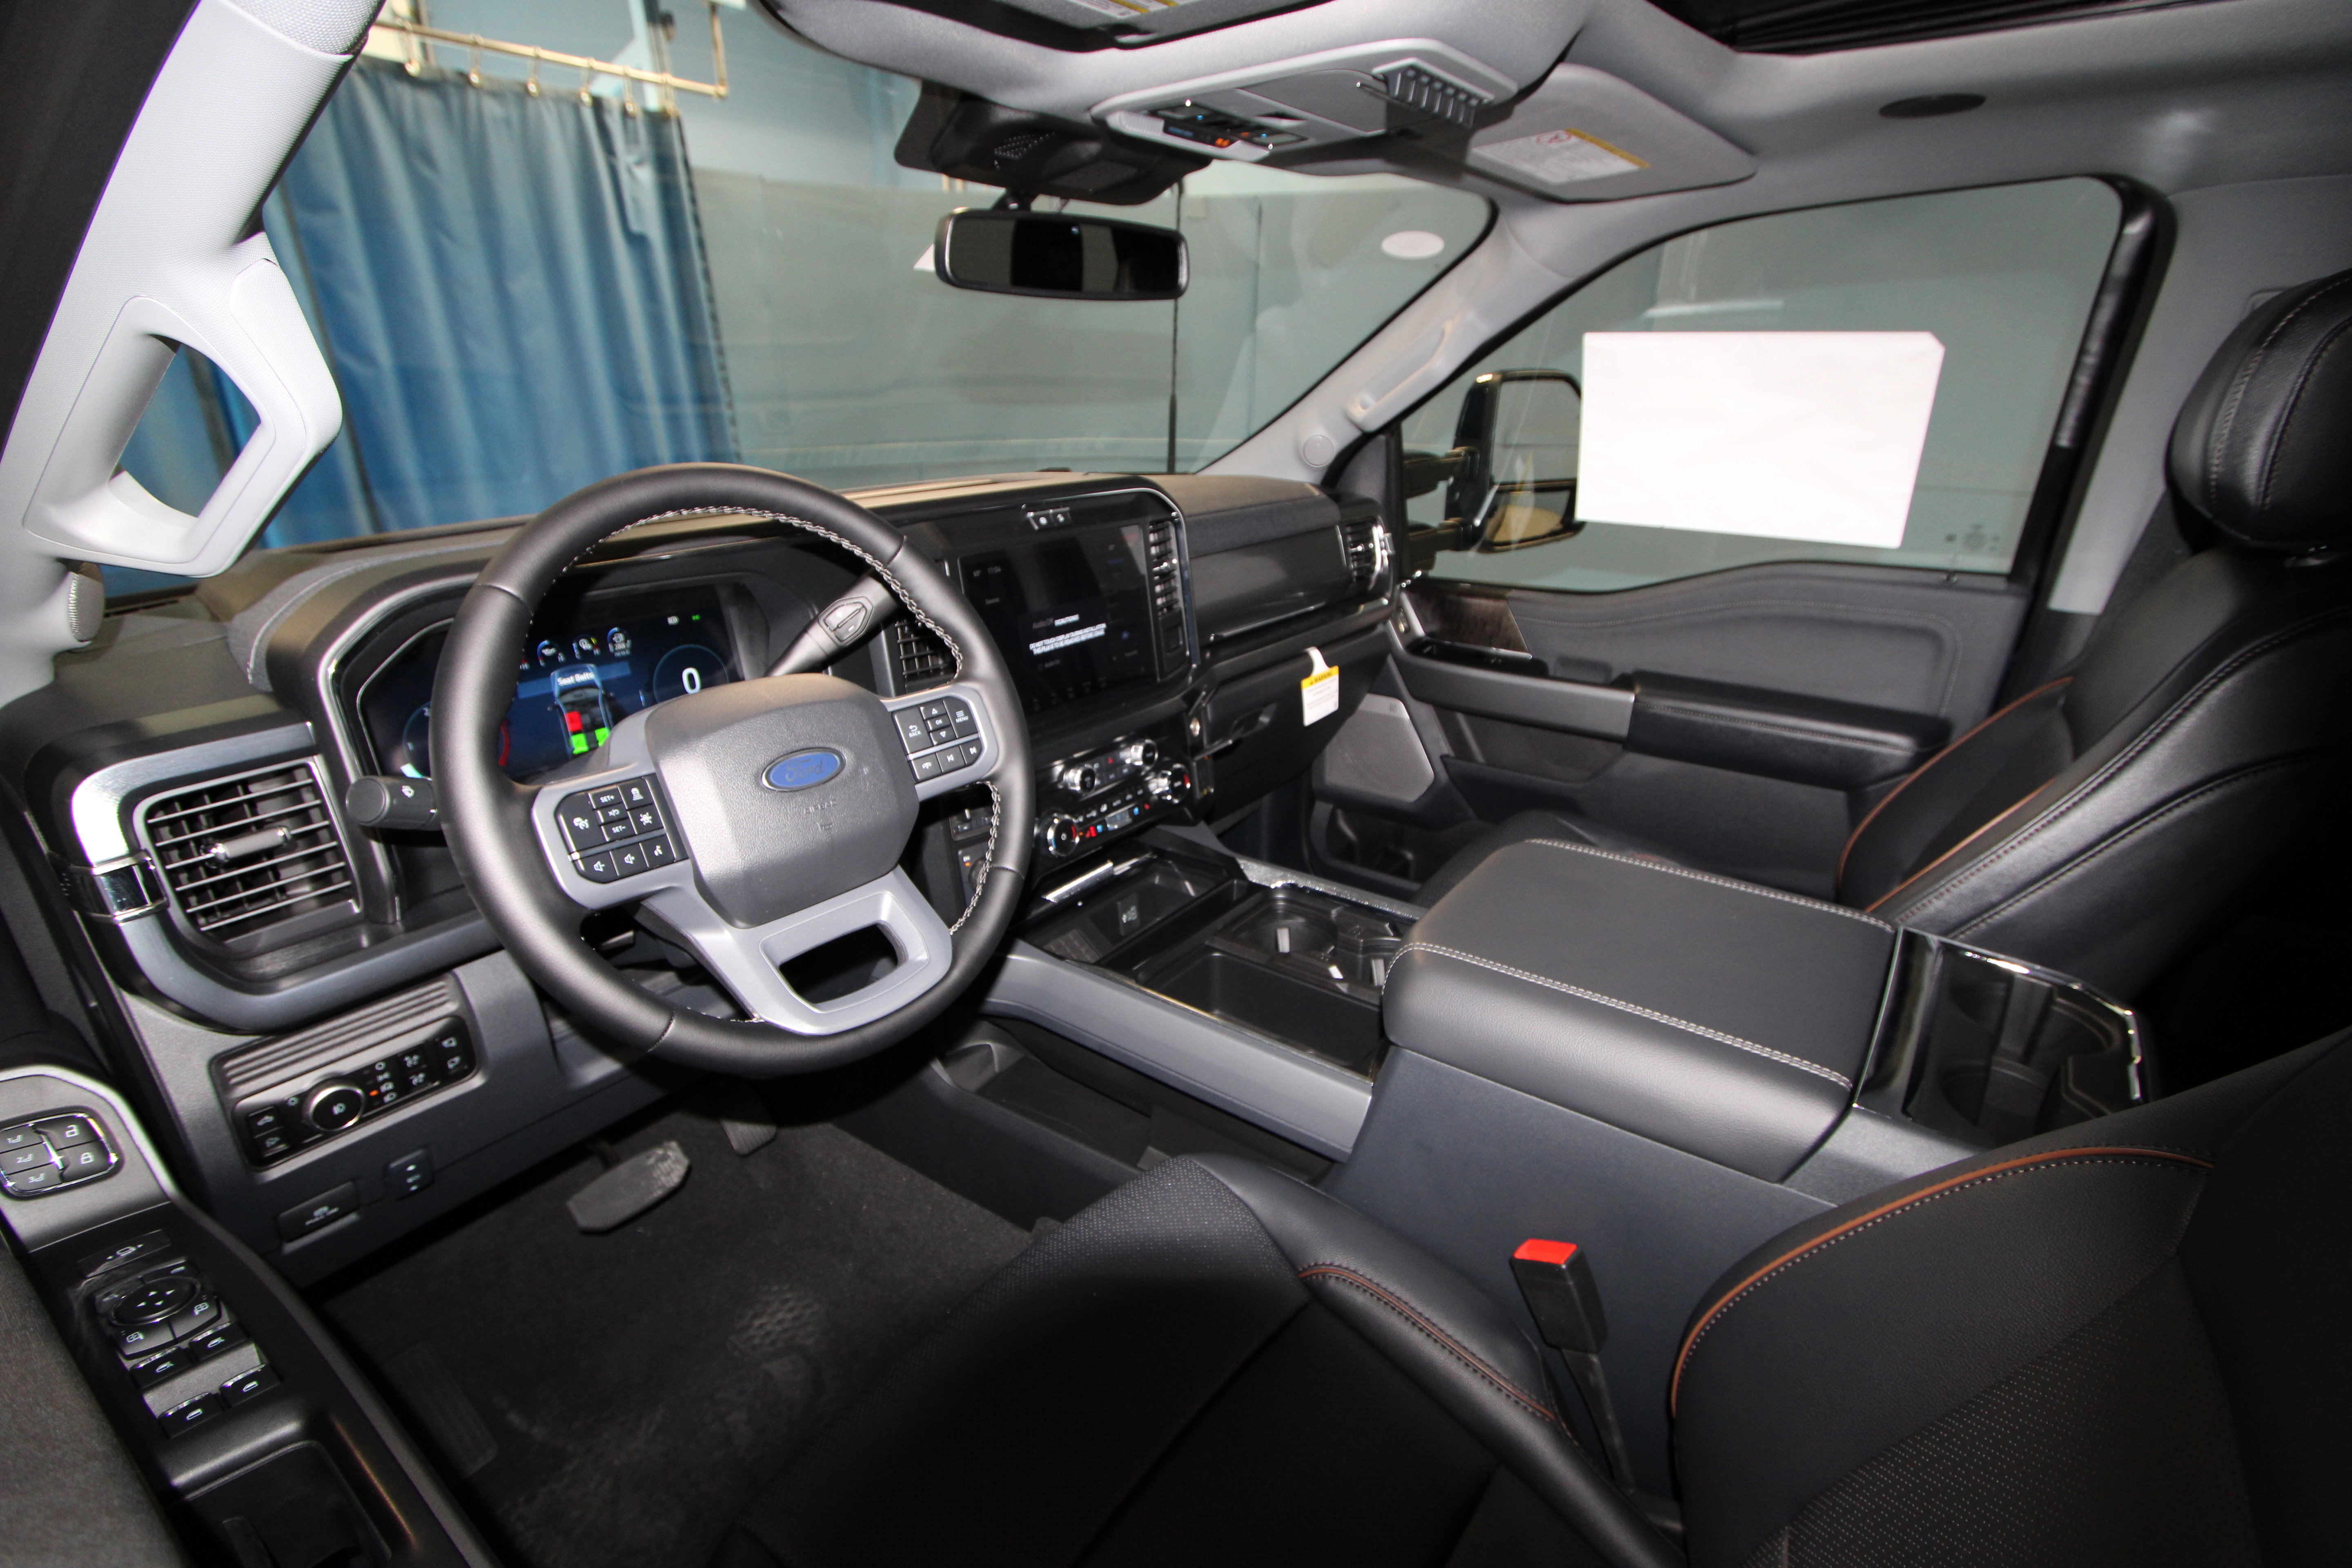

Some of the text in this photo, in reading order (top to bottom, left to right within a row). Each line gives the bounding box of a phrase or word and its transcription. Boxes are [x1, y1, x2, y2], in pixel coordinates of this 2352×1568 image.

[557, 672, 595, 687] Seat Belts
[682, 667, 702, 695] 0
[1314, 672, 1333, 682] WARNING
[785, 758, 824, 782] Ford
[600, 795, 615, 803] SET+
[612, 825, 626, 833] SET-
